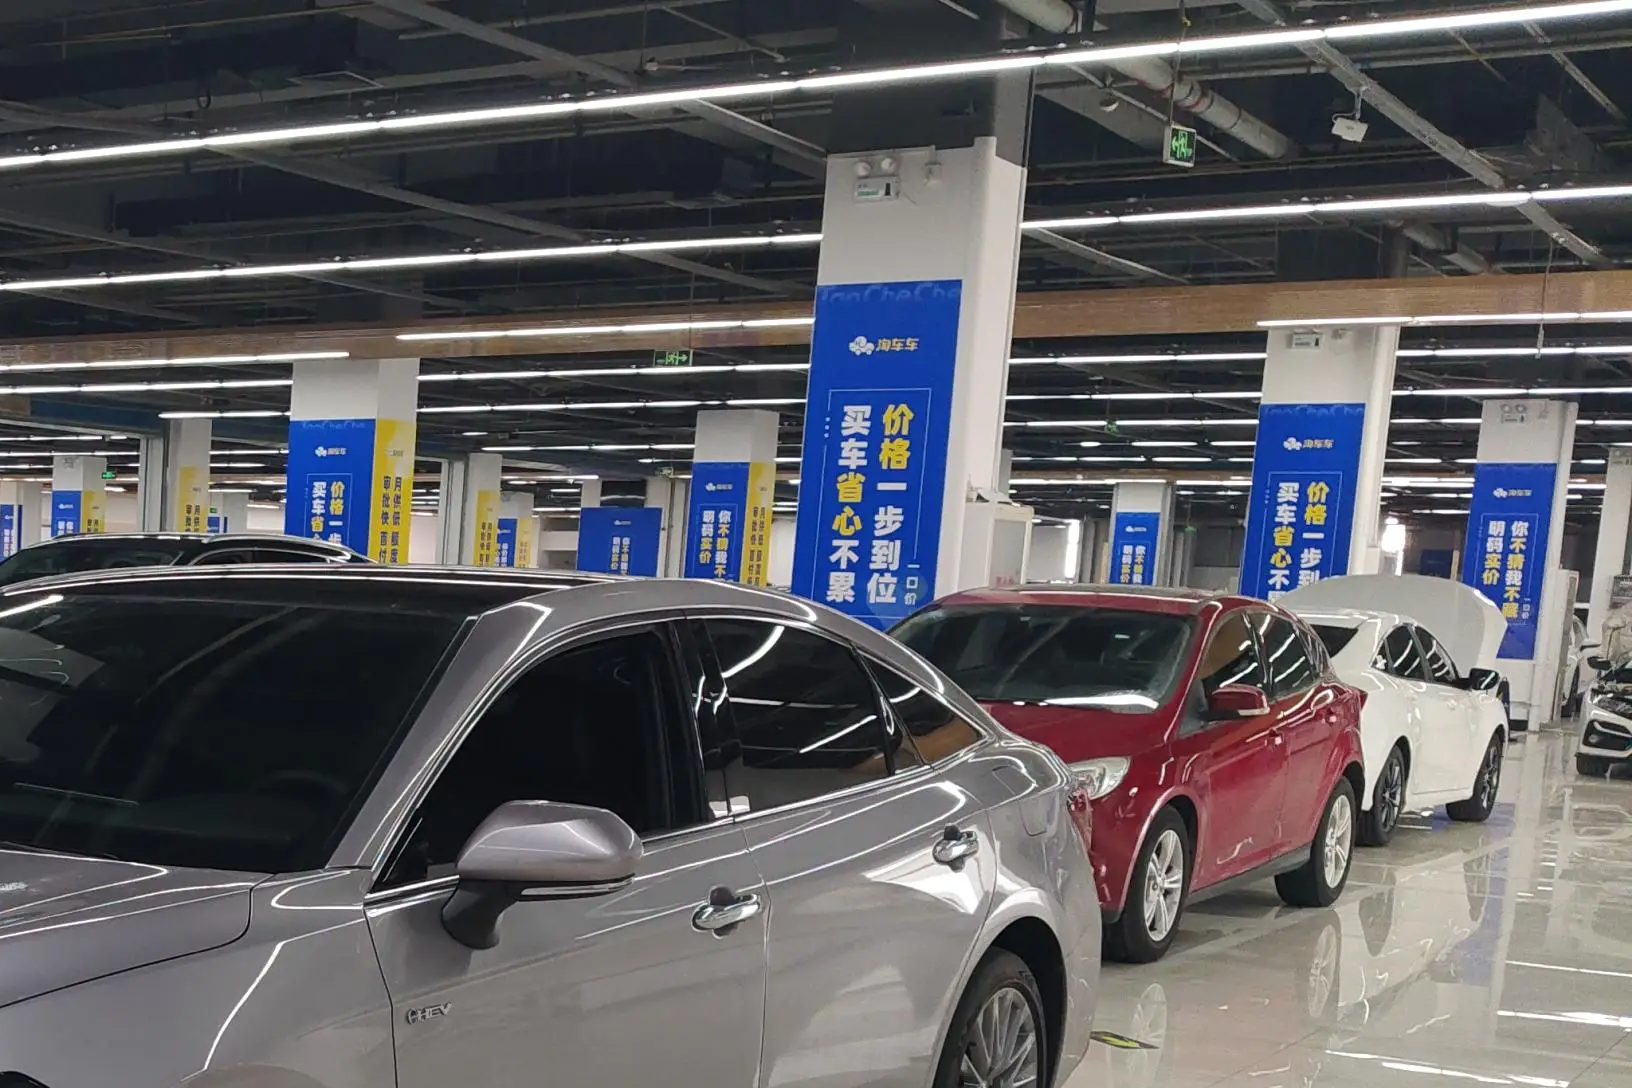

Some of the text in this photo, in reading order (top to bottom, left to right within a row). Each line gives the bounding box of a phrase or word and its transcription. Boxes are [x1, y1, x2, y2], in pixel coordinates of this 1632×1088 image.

[876, 337, 919, 351] 淘车车
[826, 404, 873, 604] 买车省心不累
[866, 403, 915, 605] 价格一步到位
[1297, 481, 1330, 589] 价格一步到
[714, 510, 732, 580] 你不猜我不
[1482, 520, 1506, 586] 明码实价
[904, 563, 921, 606] 一口价
